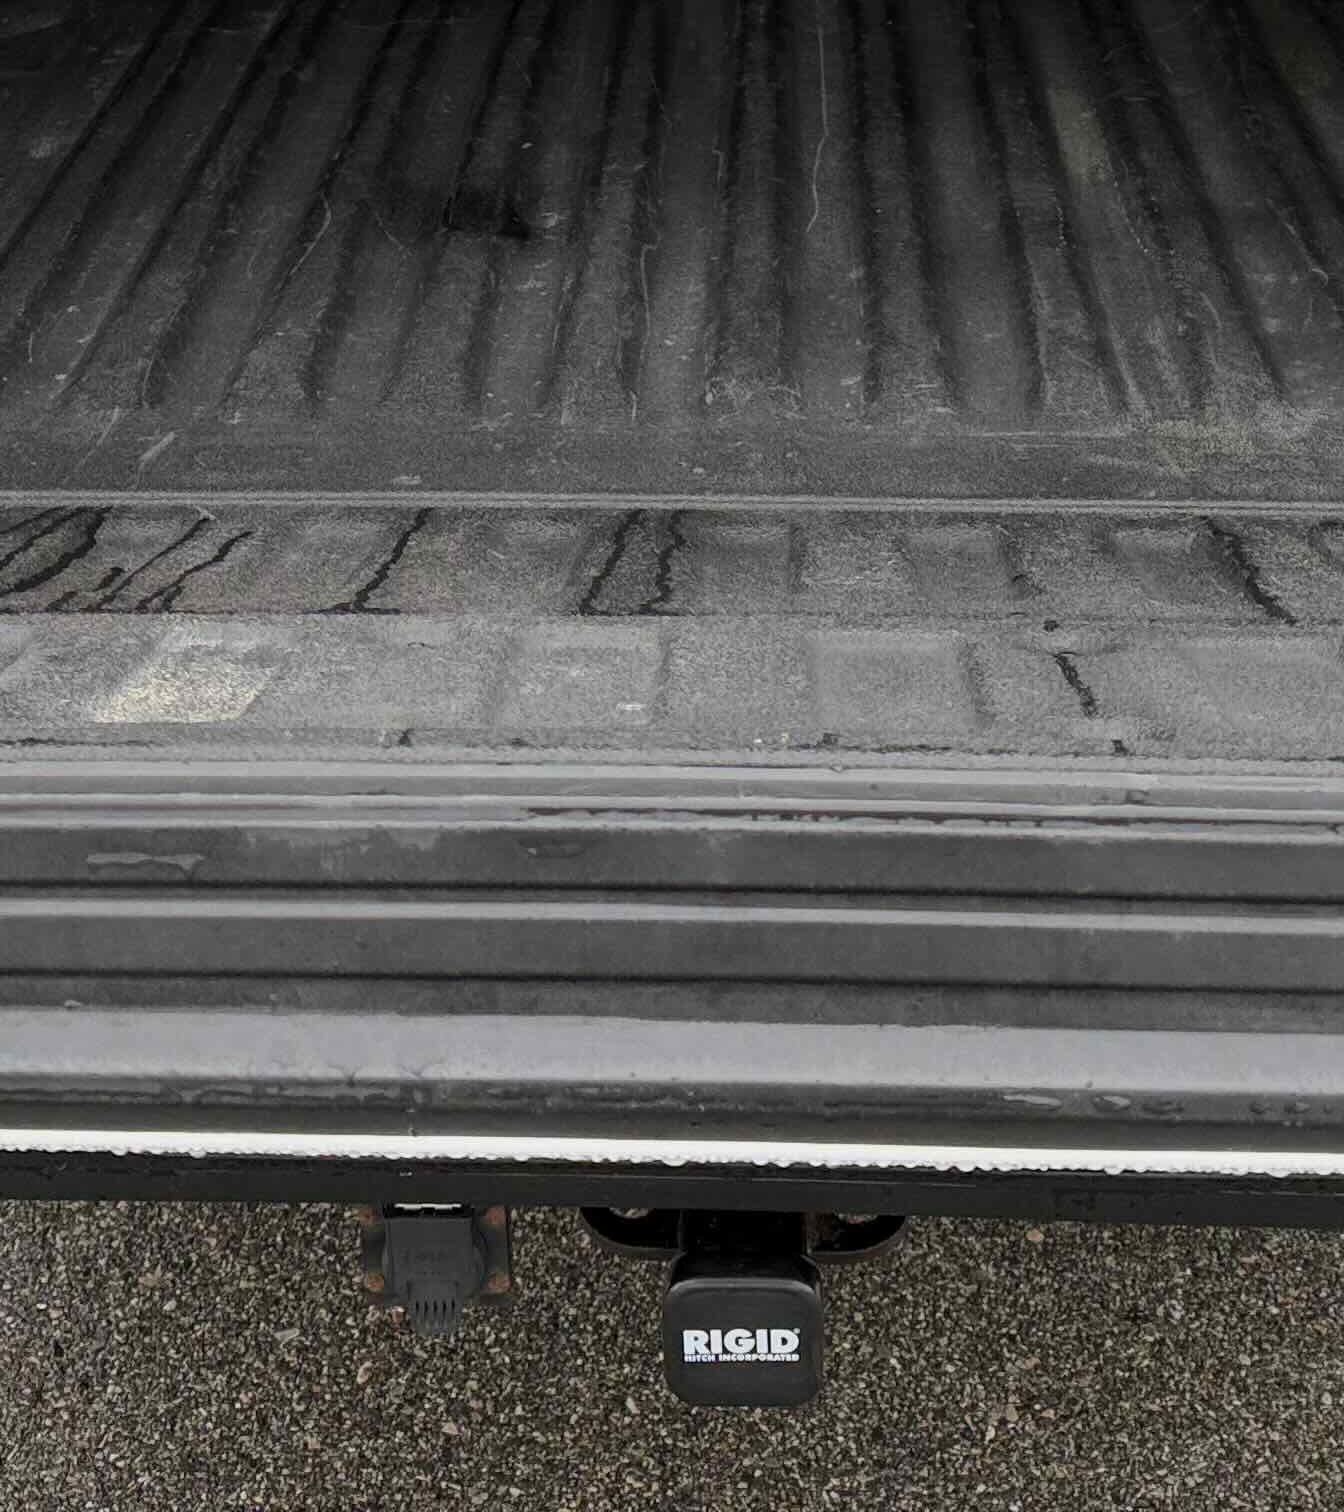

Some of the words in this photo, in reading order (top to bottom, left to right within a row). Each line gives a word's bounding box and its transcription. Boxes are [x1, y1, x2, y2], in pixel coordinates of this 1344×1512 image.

[683, 1328, 800, 1355] RIGID
[684, 1354, 716, 1362] HITCH
[718, 1354, 800, 1362] INCORPORATED
